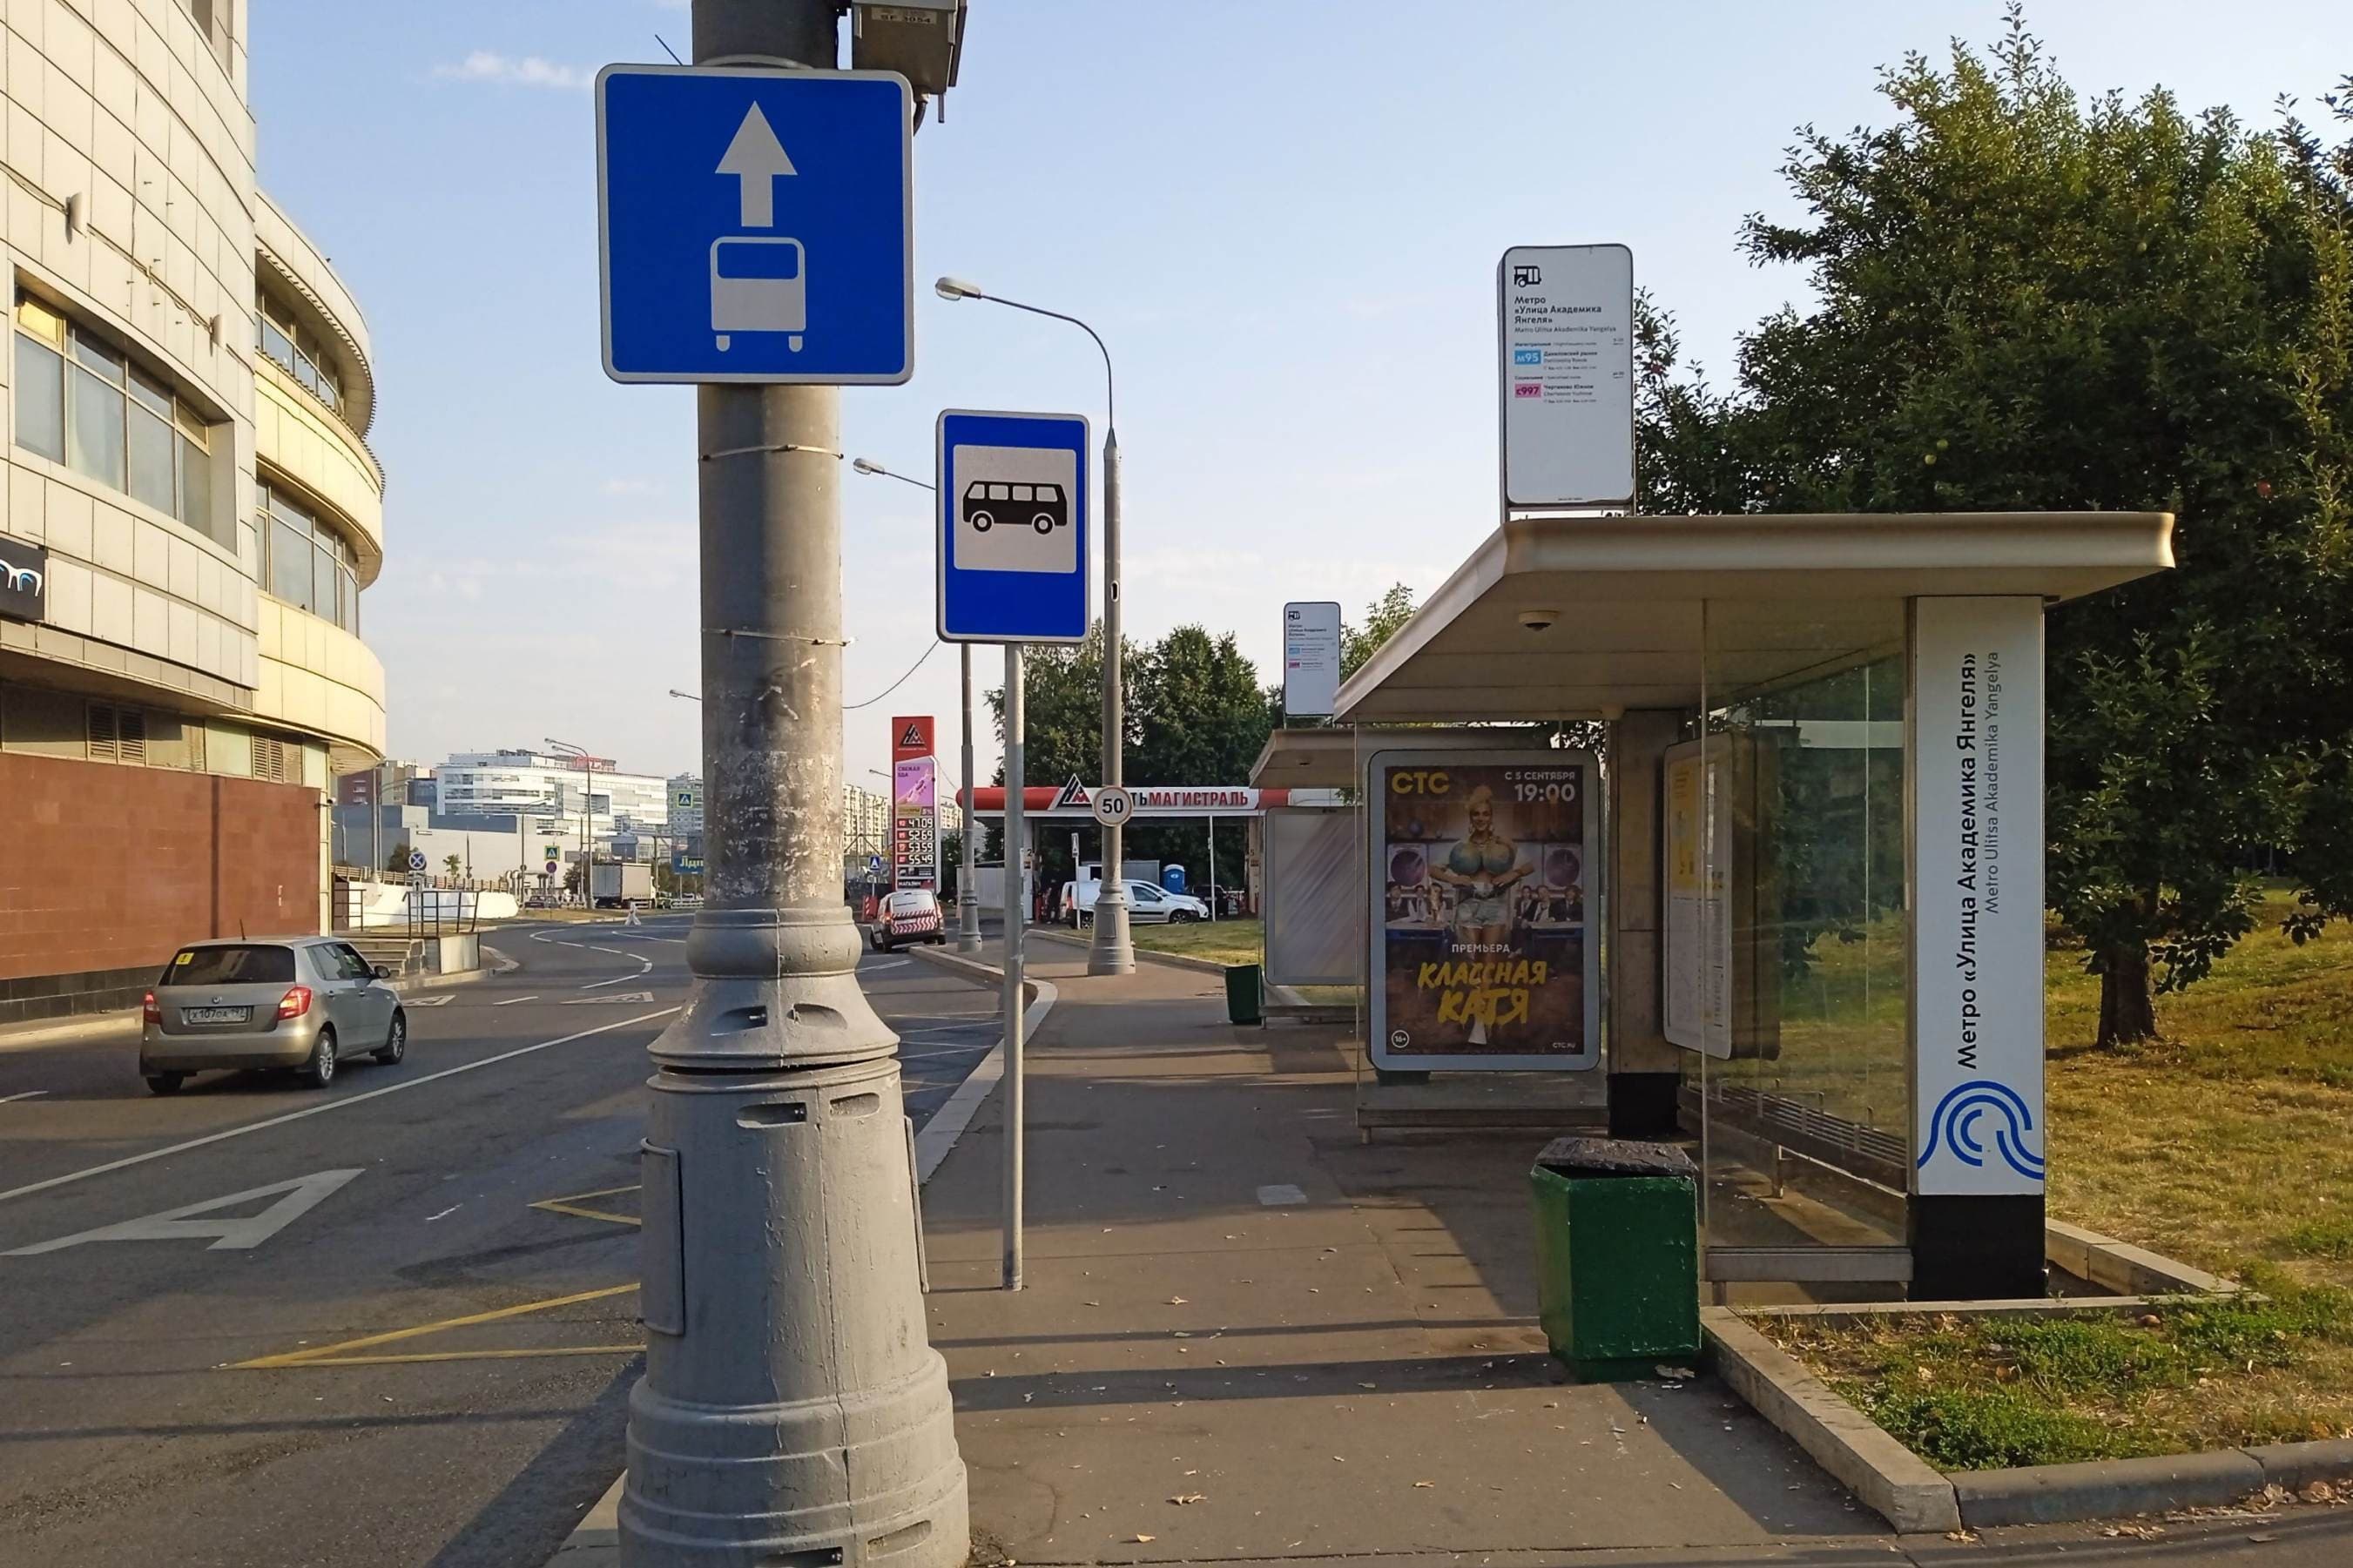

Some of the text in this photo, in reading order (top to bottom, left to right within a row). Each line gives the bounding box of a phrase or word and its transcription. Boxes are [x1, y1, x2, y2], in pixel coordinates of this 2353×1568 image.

[1514, 296, 1547, 305] Метро
[1550, 305, 1602, 314] Академика
[1392, 771, 1450, 794] СТС
[1505, 771, 1574, 781] С 5 СЕНТЯБРЯ
[1984, 652, 2001, 914] Metro Ulitsa Akademika Yangelya
[1514, 784, 1575, 801] 19:00
[1102, 798, 1123, 814] 50
[1956, 653, 1981, 1070] Метро «Улица Академика Янгеля»
[1452, 944, 1510, 953] ПРЕМЬЕРА
[1418, 959, 1547, 990] КЛАССНАЯ
[1438, 987, 1529, 1026] КАТЯ
